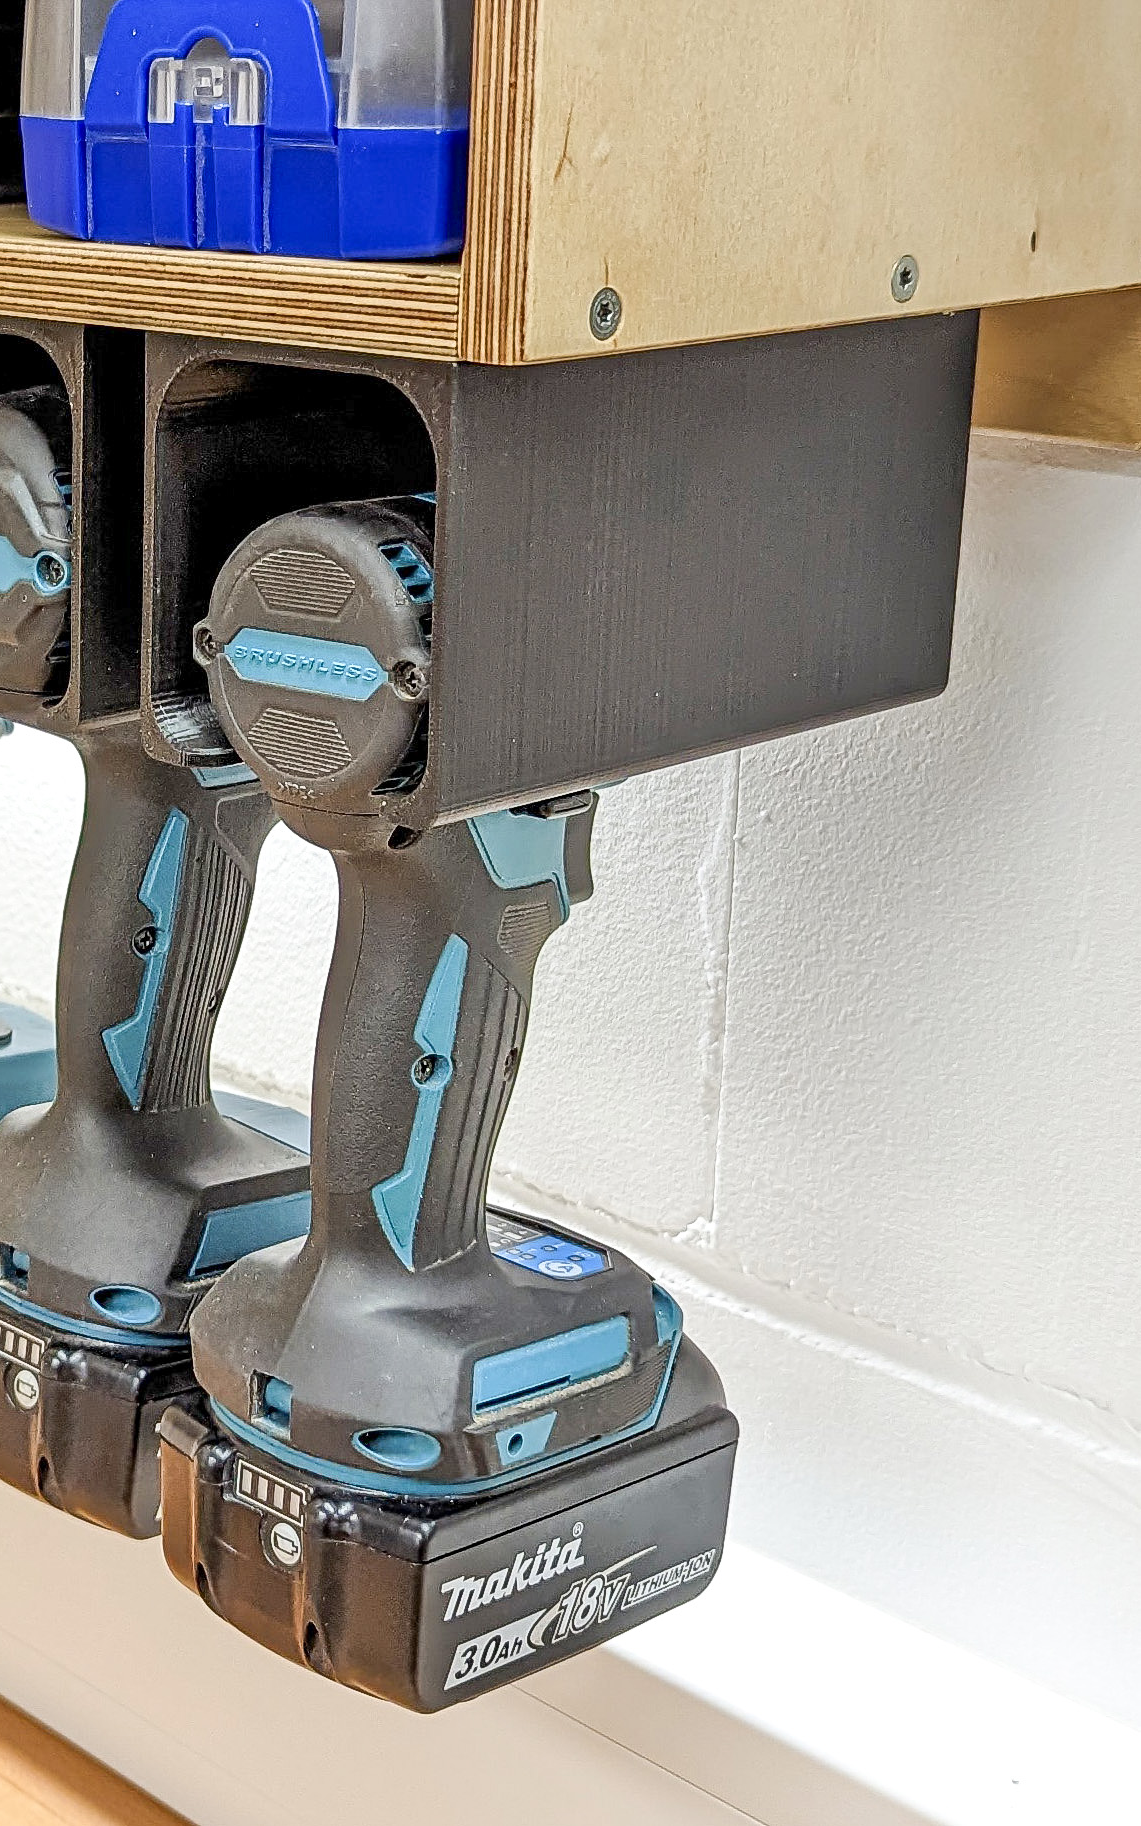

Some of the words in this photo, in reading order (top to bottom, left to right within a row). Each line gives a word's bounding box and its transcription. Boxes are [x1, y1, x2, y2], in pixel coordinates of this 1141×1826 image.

[234, 645, 378, 681] BRUSHLESS
[454, 1633, 523, 1680] 3.0Ah
[551, 1570, 632, 1644] 18V
